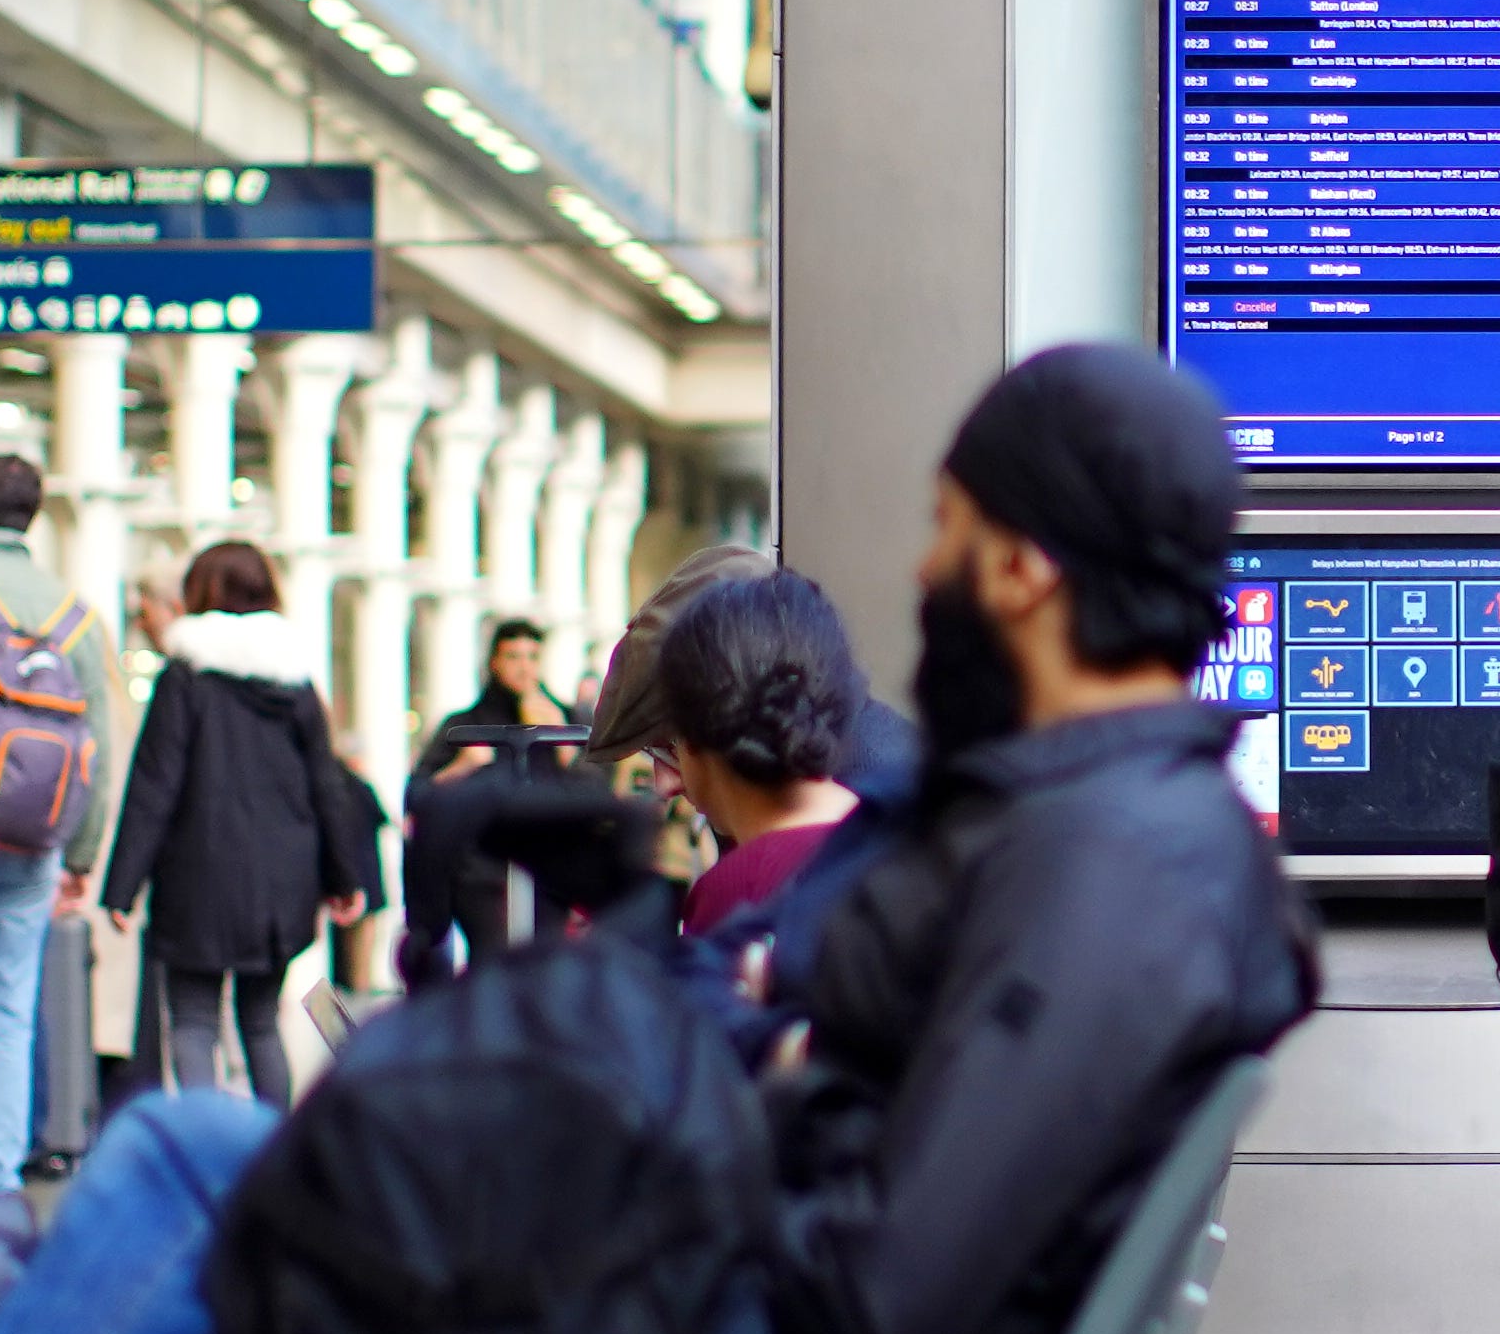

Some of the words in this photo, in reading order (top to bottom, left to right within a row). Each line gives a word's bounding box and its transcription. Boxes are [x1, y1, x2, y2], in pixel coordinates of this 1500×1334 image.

[1339, 0, 1379, 13] (London)
[1234, 37, 1248, 50] On
[1247, 37, 1269, 50] time
[1309, 37, 1337, 50] Luton
[1234, 75, 1248, 87] On
[1247, 75, 1269, 87] time
[1309, 75, 1357, 89] Cambridge
[1234, 113, 1248, 125] On
[1247, 113, 1269, 125] time
[1309, 113, 1349, 127] Brighton
[1234, 150, 1248, 162] On
[1247, 150, 1269, 162] time
[1309, 150, 1350, 162] Sheffield
[78, 172, 132, 204] Rail
[1234, 188, 1248, 200] On
[1247, 188, 1269, 200] time
[1234, 225, 1248, 238] On
[1247, 225, 1269, 238] time
[1321, 225, 1351, 238] Albans
[1234, 263, 1248, 275] On
[1247, 263, 1269, 275] time
[1234, 301, 1277, 313] Cancelled
[1309, 301, 1336, 313] Three
[1336, 301, 1371, 315] Bridges
[1387, 430, 1416, 445] Page
[1415, 431, 1421, 442] 1
[1421, 430, 1435, 443] of
[1434, 431, 1445, 443] 2
